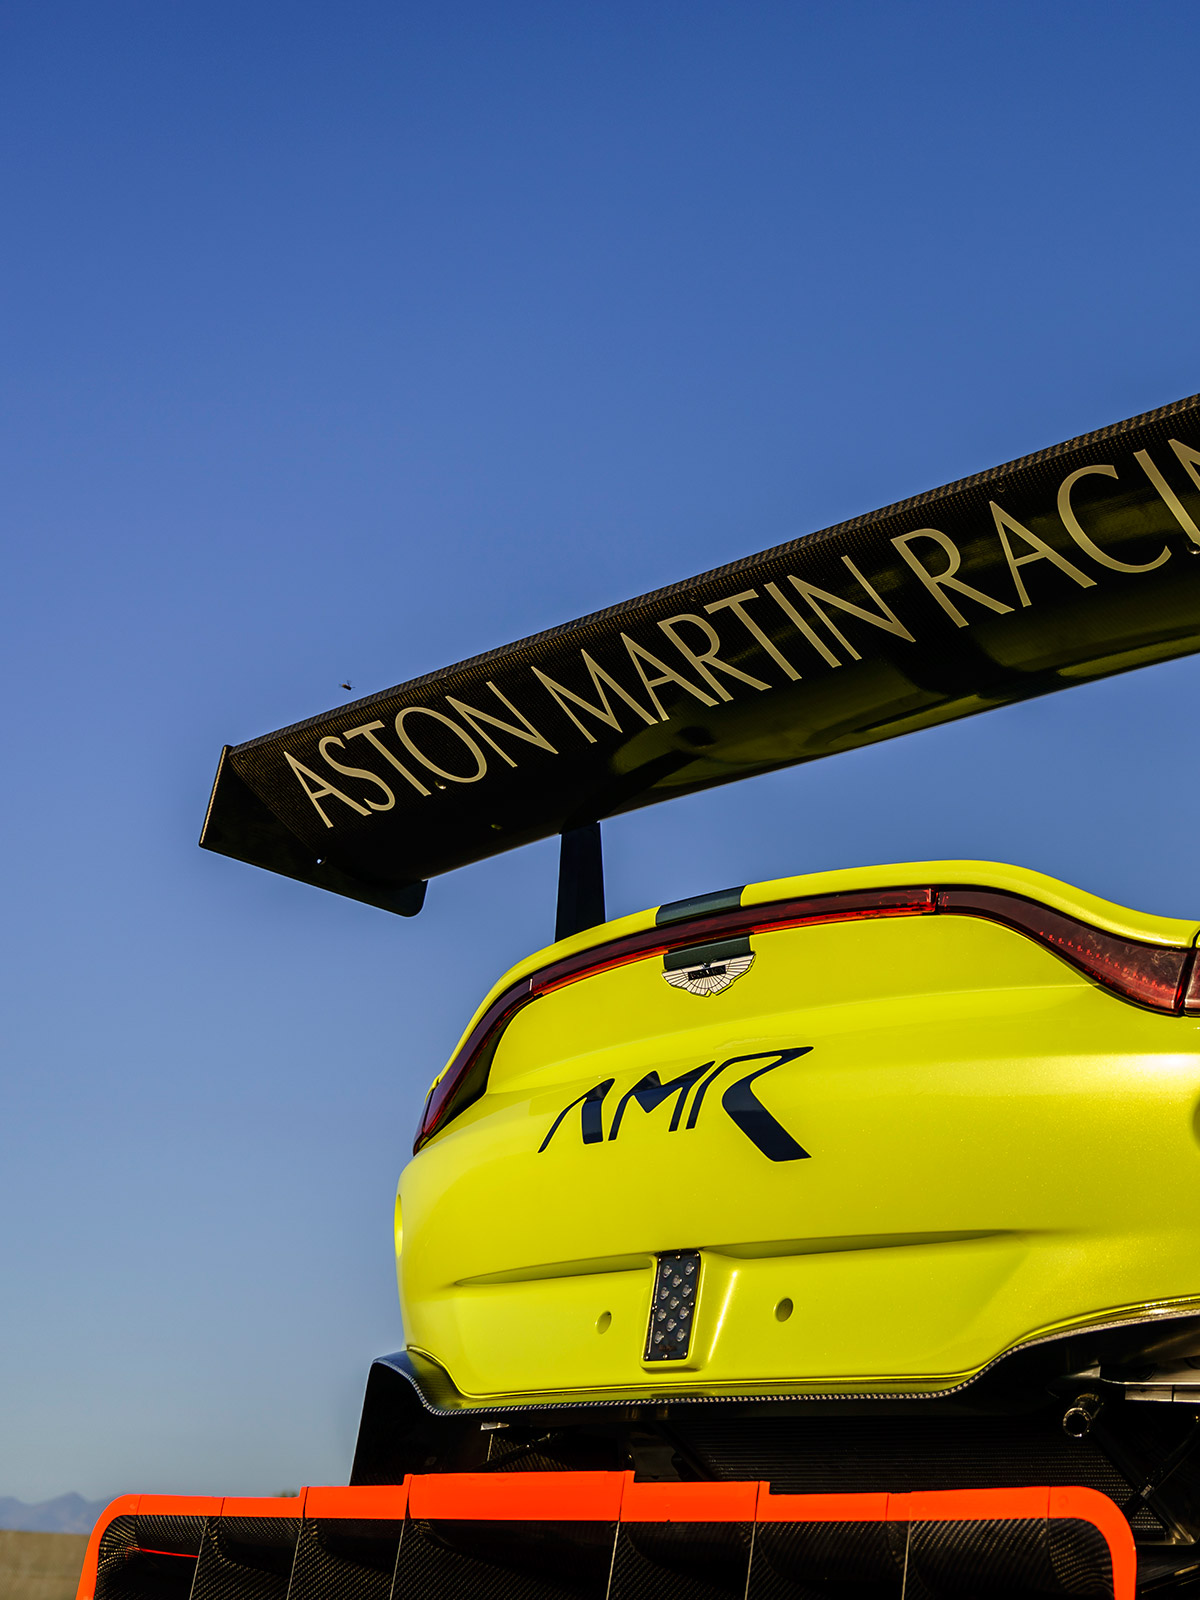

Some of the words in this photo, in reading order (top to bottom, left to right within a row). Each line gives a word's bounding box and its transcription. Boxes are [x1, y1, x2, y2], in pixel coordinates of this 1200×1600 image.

[283, 681, 559, 829] ASTON
[531, 554, 916, 743] MARTIN
[537, 1046, 814, 1162] AMR
